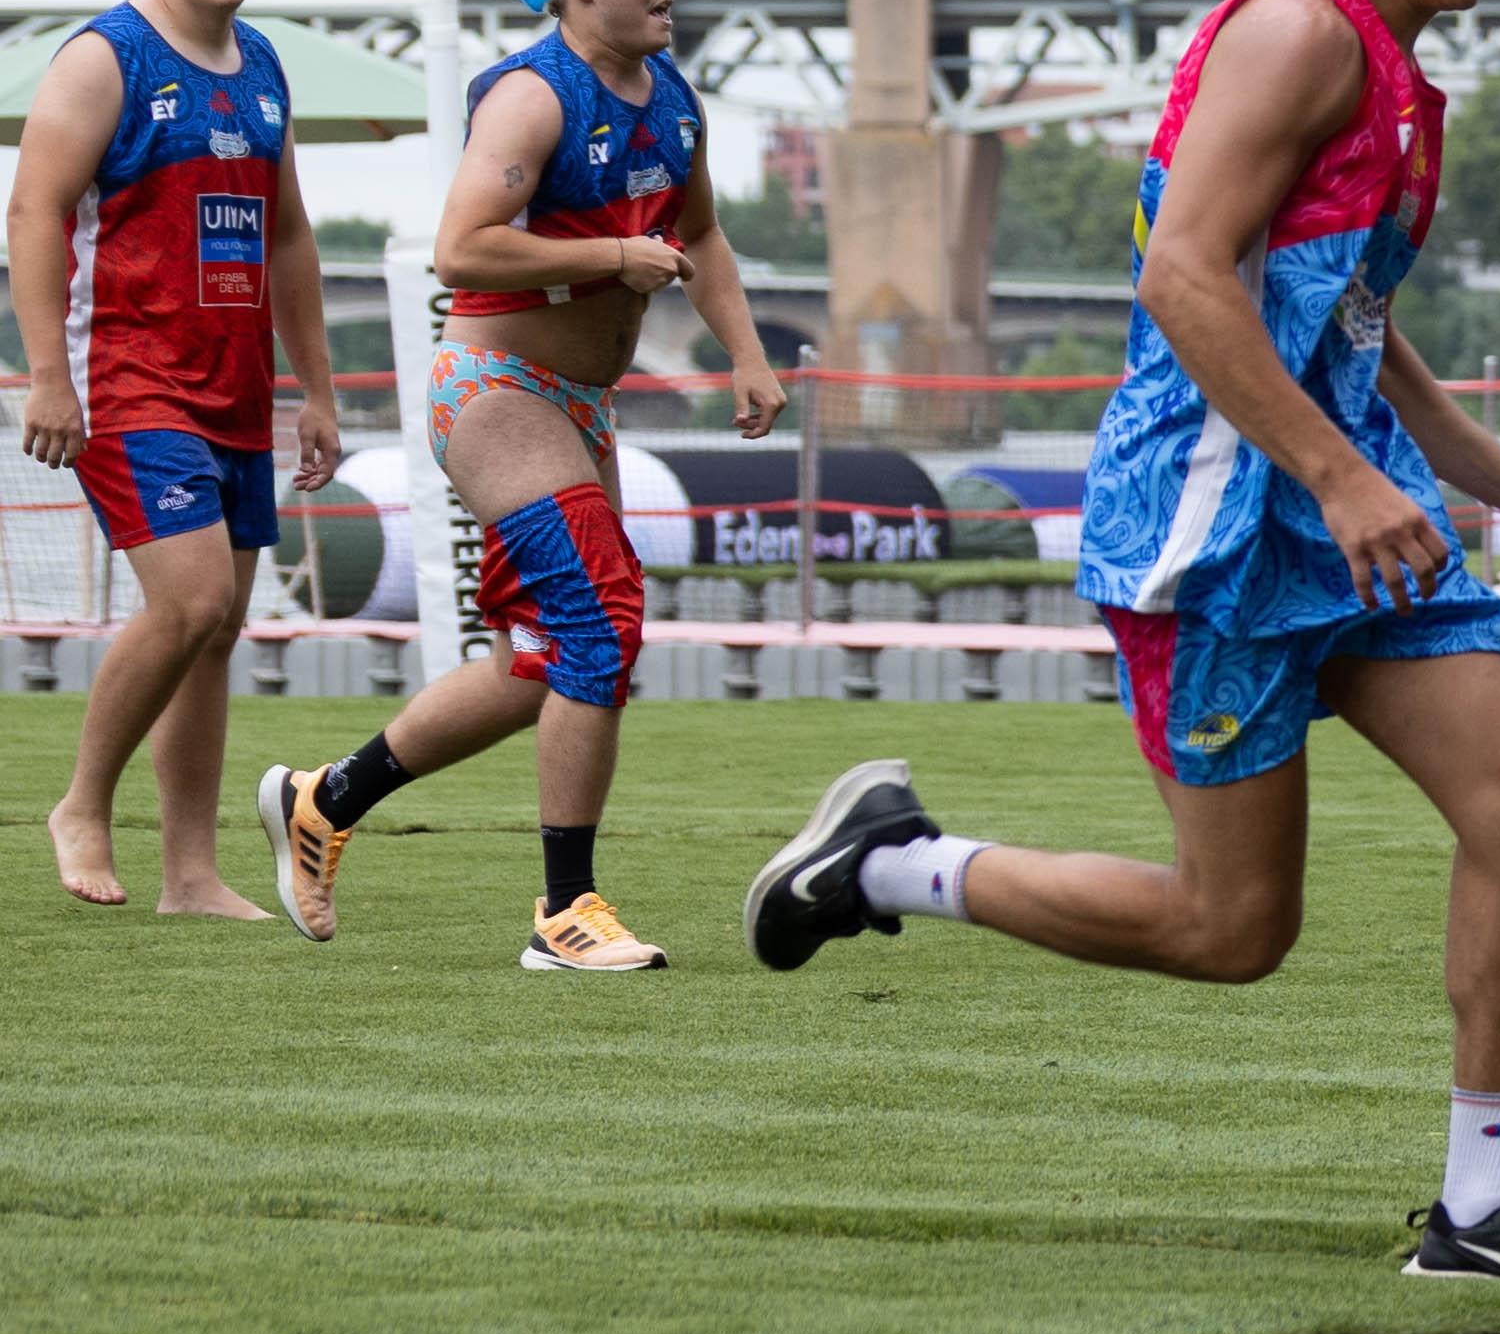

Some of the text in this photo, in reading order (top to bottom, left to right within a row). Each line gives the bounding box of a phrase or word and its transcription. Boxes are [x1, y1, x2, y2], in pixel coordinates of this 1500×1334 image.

[150, 98, 177, 121] EY
[713, 504, 941, 564] Eden Park
